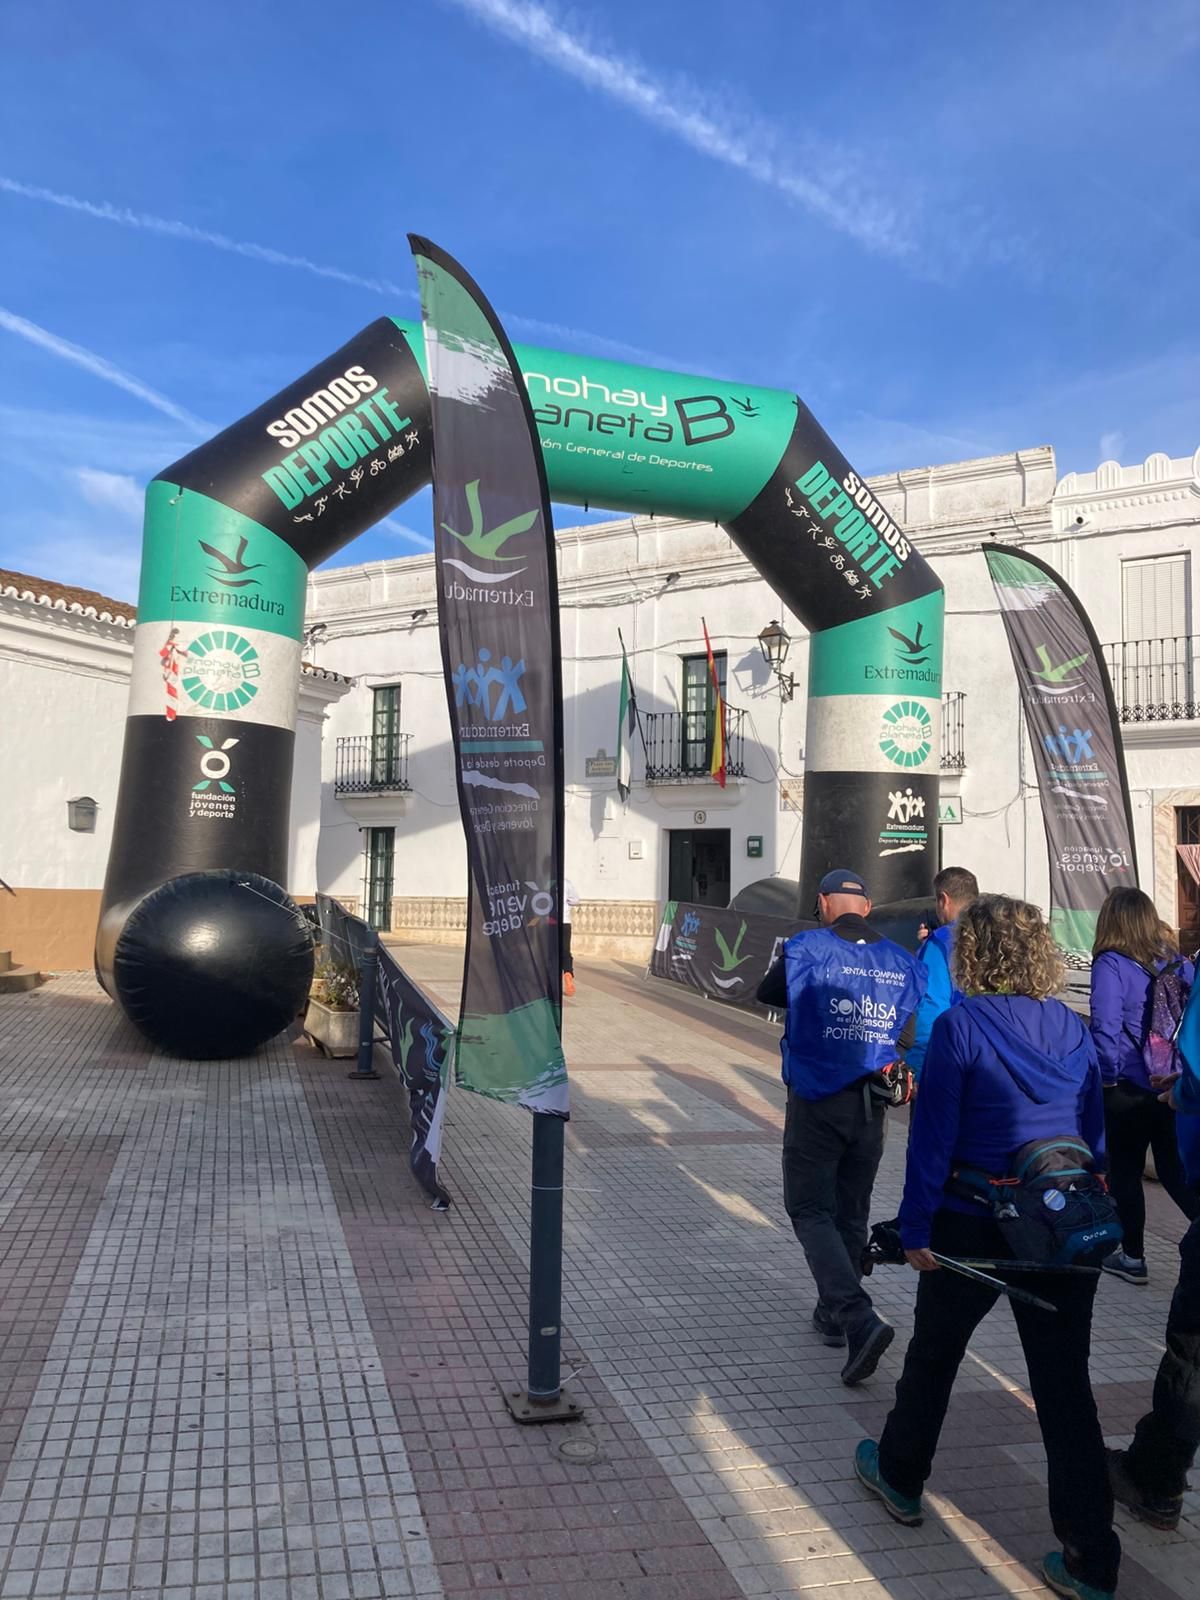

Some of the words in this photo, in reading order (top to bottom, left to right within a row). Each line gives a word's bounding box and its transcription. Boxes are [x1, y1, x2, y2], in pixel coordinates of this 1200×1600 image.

[266, 365, 378, 448] SOMOS
[523, 371, 667, 417] nohay
[535, 403, 673, 443] aneta
[674, 395, 736, 446] B
[261, 387, 412, 511] DEPORTE
[566, 442, 625, 460] General
[627, 452, 647, 463] de
[649, 455, 714, 473] Deportes
[795, 460, 903, 590] DEPORTE
[842, 471, 912, 561] SOMOS
[170, 586, 286, 616] Extremadura
[241, 662, 261, 679] B
[189, 800, 235, 811] jóvenes
[191, 791, 236, 802] fundación
[197, 809, 234, 818] deporte
[868, 969, 906, 981] COMPANY
[829, 997, 897, 1020] SONRISA
[825, 1026, 873, 1043] POTENTE
[852, 1015, 894, 1030] Mensaje
